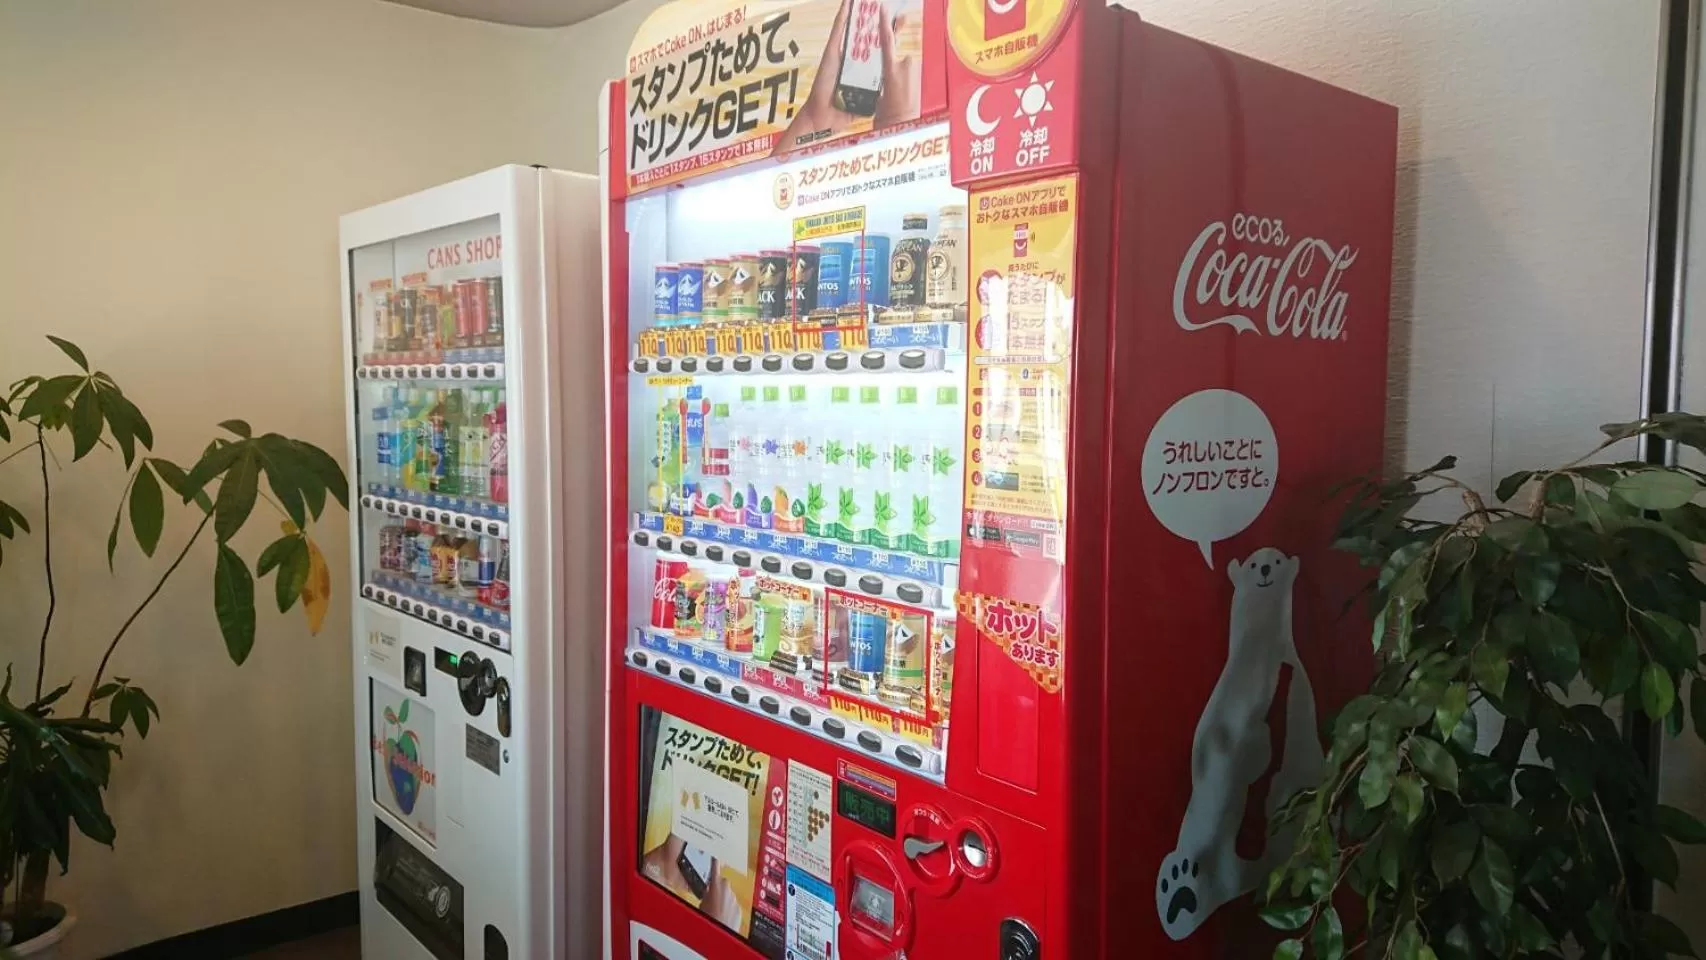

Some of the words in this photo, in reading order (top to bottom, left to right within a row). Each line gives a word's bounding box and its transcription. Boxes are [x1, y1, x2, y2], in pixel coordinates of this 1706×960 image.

[975, 33, 1039, 65] スマホ自販機
[629, 12, 801, 118] スタンプためて、
[629, 67, 800, 170] ドリンクGET!
[969, 137, 995, 158] 冷却
[1019, 127, 1048, 149] 冷却
[970, 157, 994, 175] ON
[1016, 146, 1050, 167] OFF
[976, 199, 1069, 224] おトクなスマホ自販機
[991, 194, 1014, 208] Coke
[427, 243, 461, 270] CANS
[1172, 221, 1360, 340] Coca-Cola
[743, 329, 763, 350] 110
[771, 329, 793, 349] 110
[1163, 439, 1262, 464] うれしいことに
[1152, 465, 1269, 495] ノンフロンですと。
[986, 601, 1057, 645] ホット
[1010, 642, 1060, 668] あります
[664, 726, 763, 770] スタンプためて、
